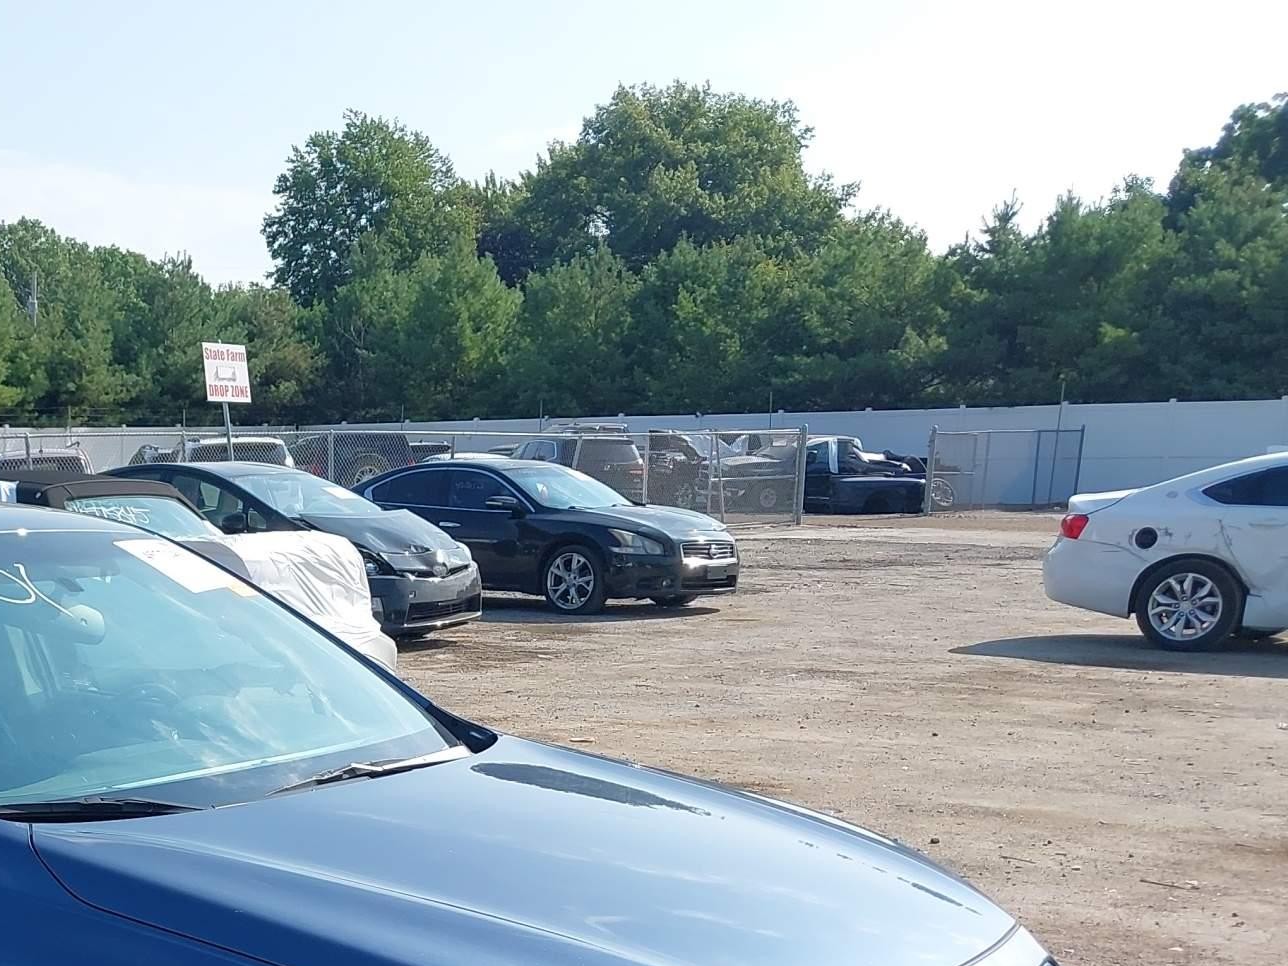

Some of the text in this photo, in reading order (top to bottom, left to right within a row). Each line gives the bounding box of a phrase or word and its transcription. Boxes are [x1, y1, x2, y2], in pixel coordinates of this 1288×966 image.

[204, 347, 246, 362] State Farm
[209, 384, 248, 398] DROP ZONE
